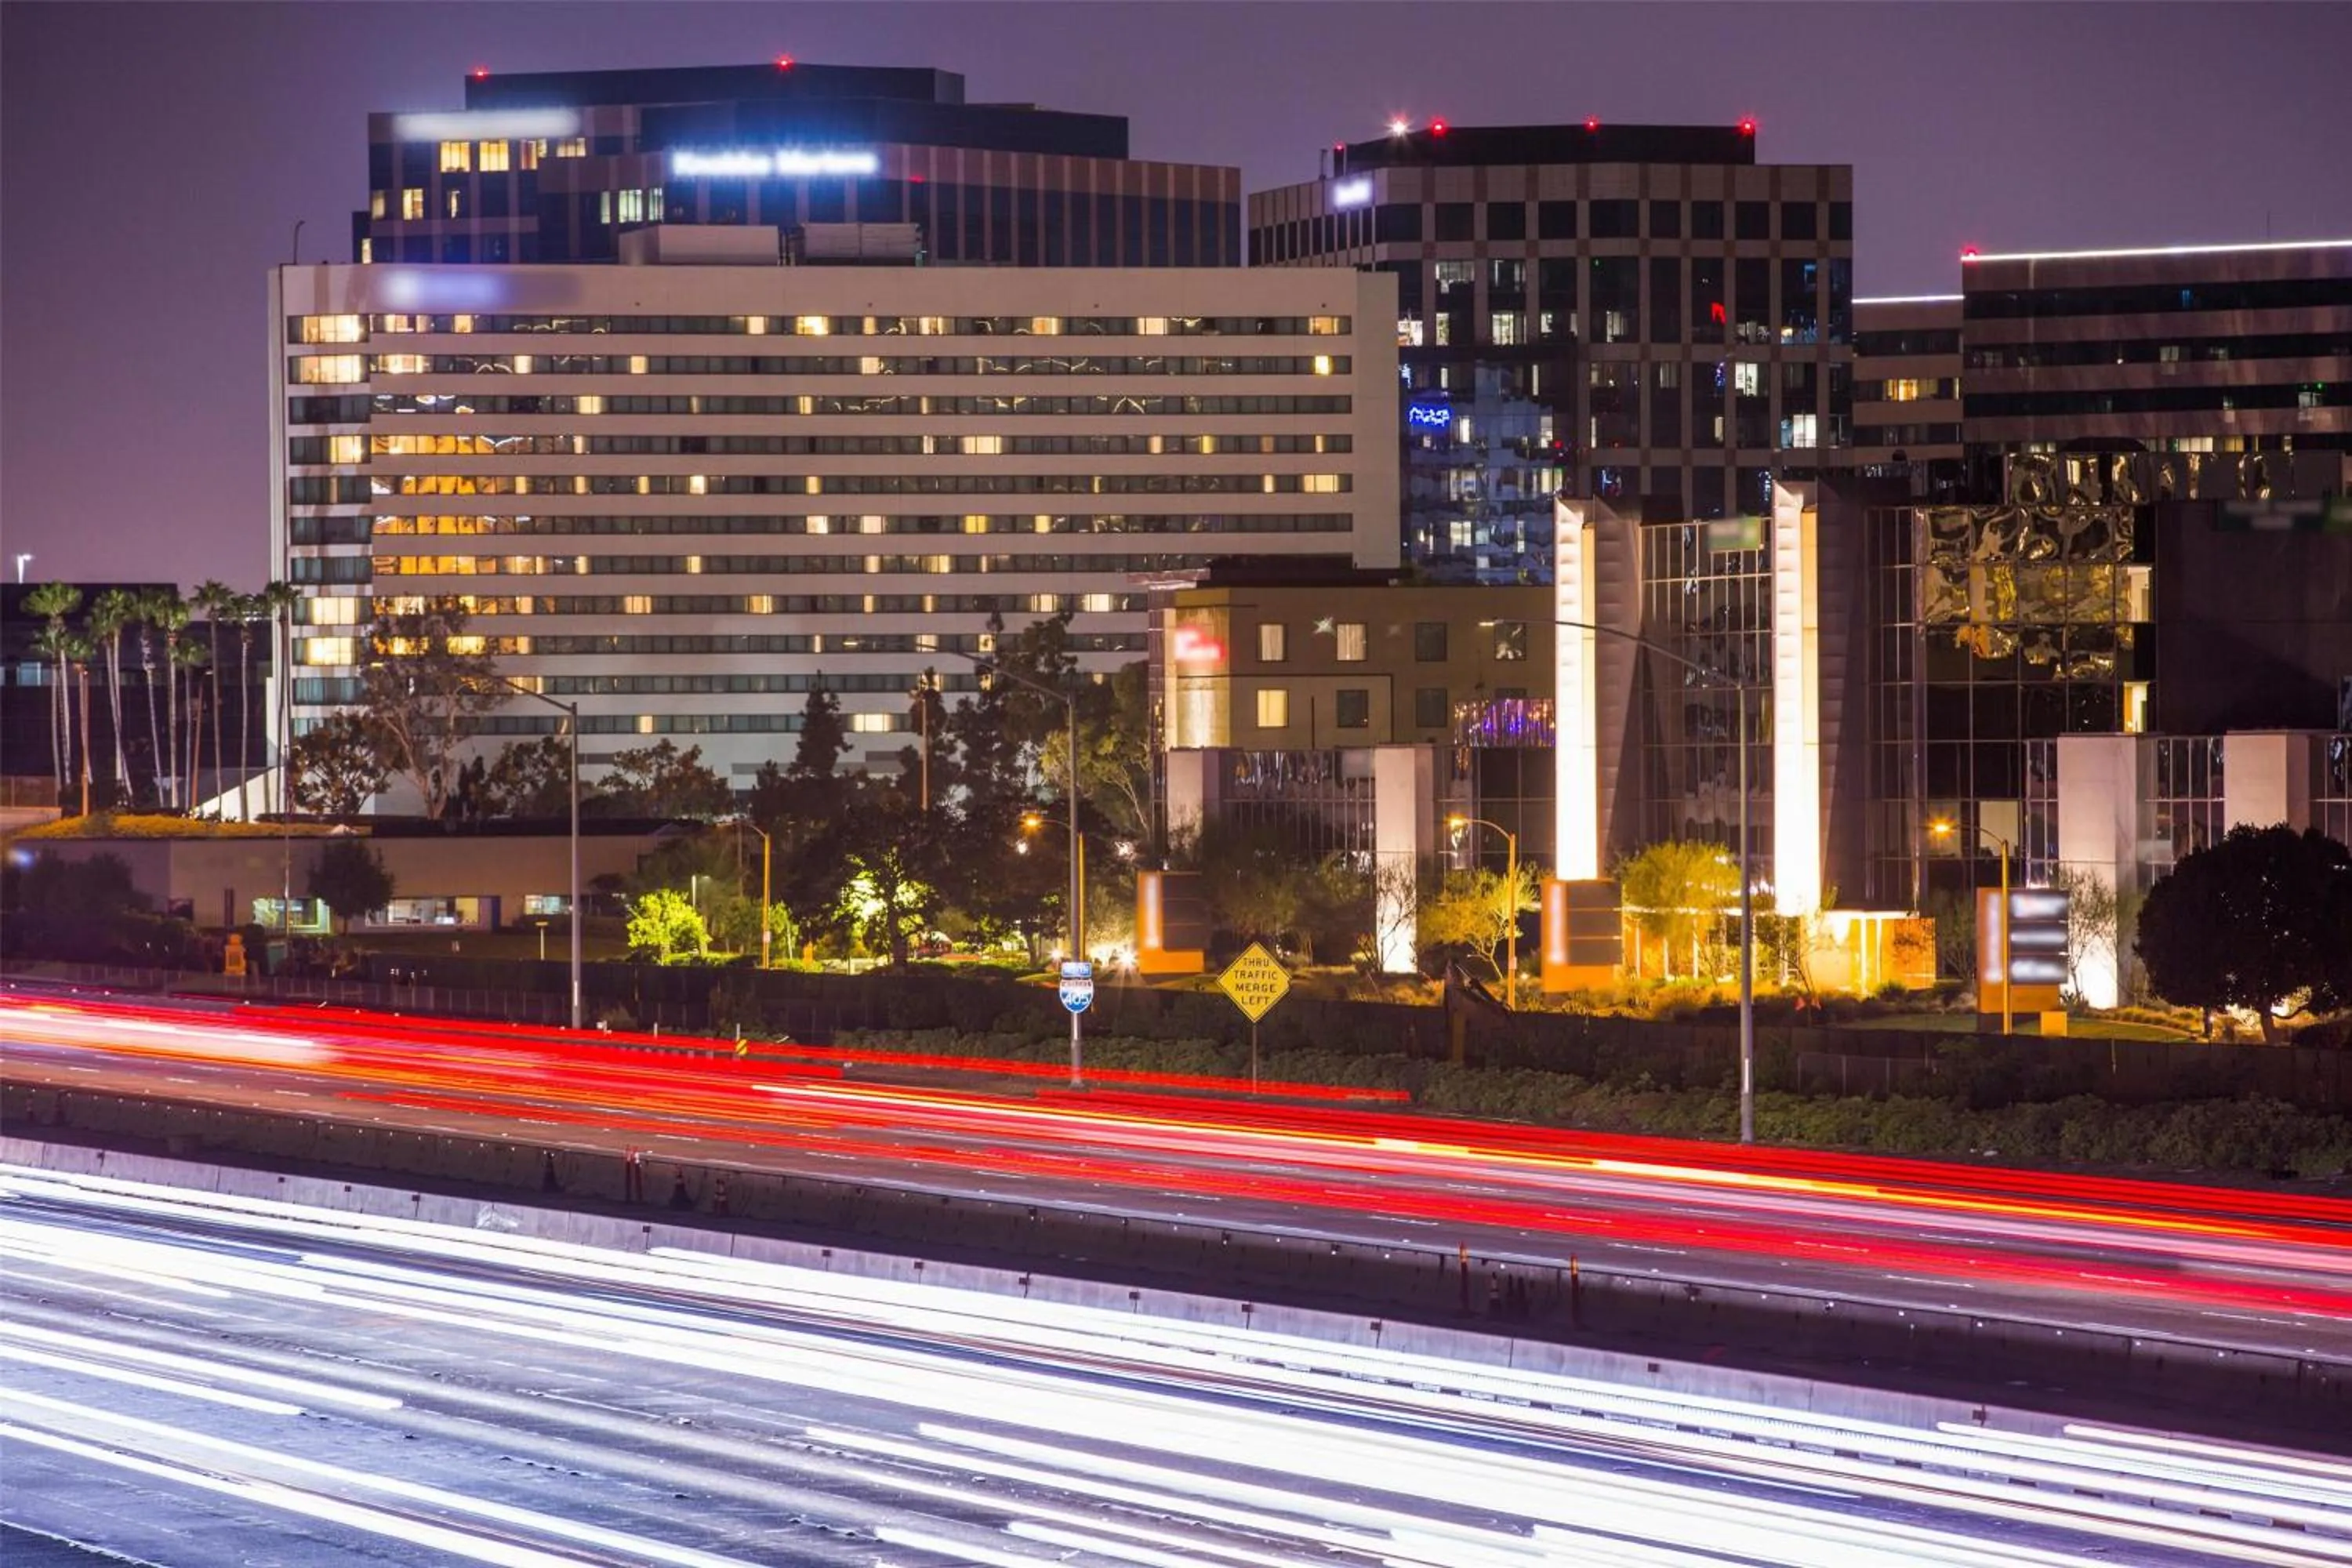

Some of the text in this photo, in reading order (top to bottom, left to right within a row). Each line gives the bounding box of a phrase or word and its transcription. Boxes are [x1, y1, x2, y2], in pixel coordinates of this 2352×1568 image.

[1243, 957, 1270, 967] THRU
[1234, 971, 1278, 980] TRAFFIC
[1235, 983, 1277, 993] MERGE
[1241, 996, 1271, 1006] LEFT
